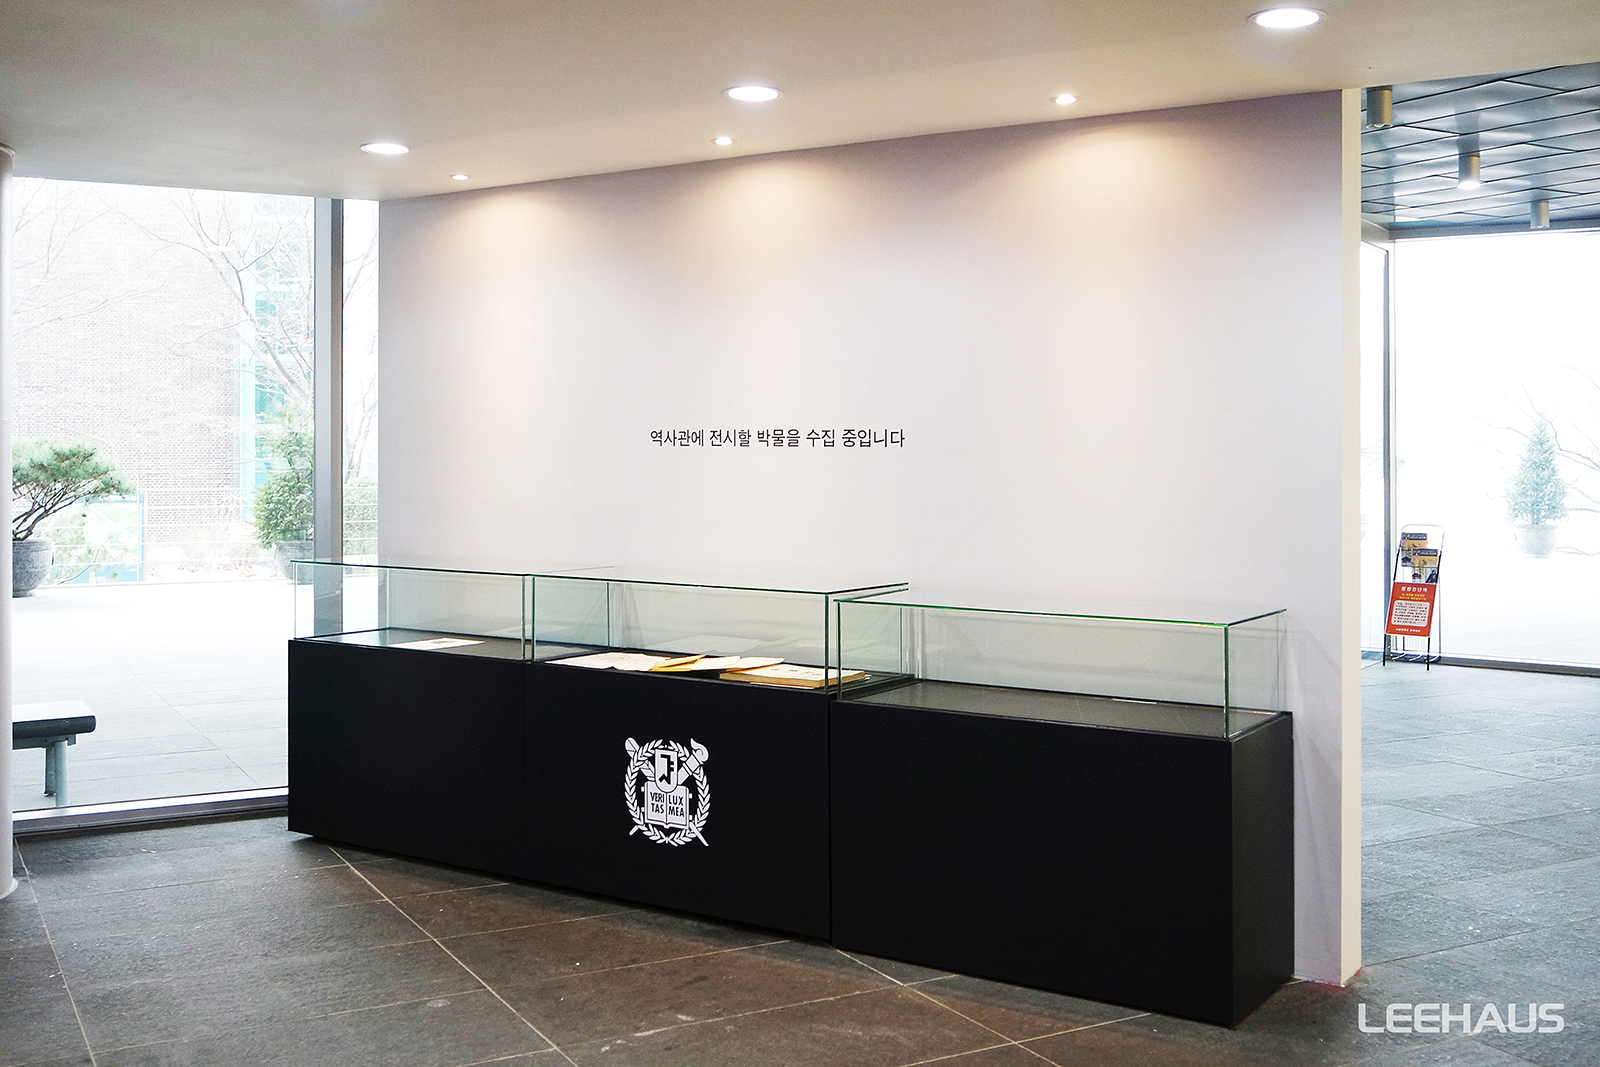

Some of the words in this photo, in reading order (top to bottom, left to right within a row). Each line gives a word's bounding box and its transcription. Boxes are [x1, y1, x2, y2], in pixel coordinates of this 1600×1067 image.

[650, 429, 704, 447] 역사관에
[709, 429, 752, 447] 전시할
[757, 429, 801, 447] 박물을
[805, 428, 835, 448] 수집
[841, 428, 906, 448] 중입니다
[650, 792, 665, 803] VERI
[668, 795, 684, 806] LUX
[651, 803, 665, 814] TAS
[668, 806, 685, 817] MEA
